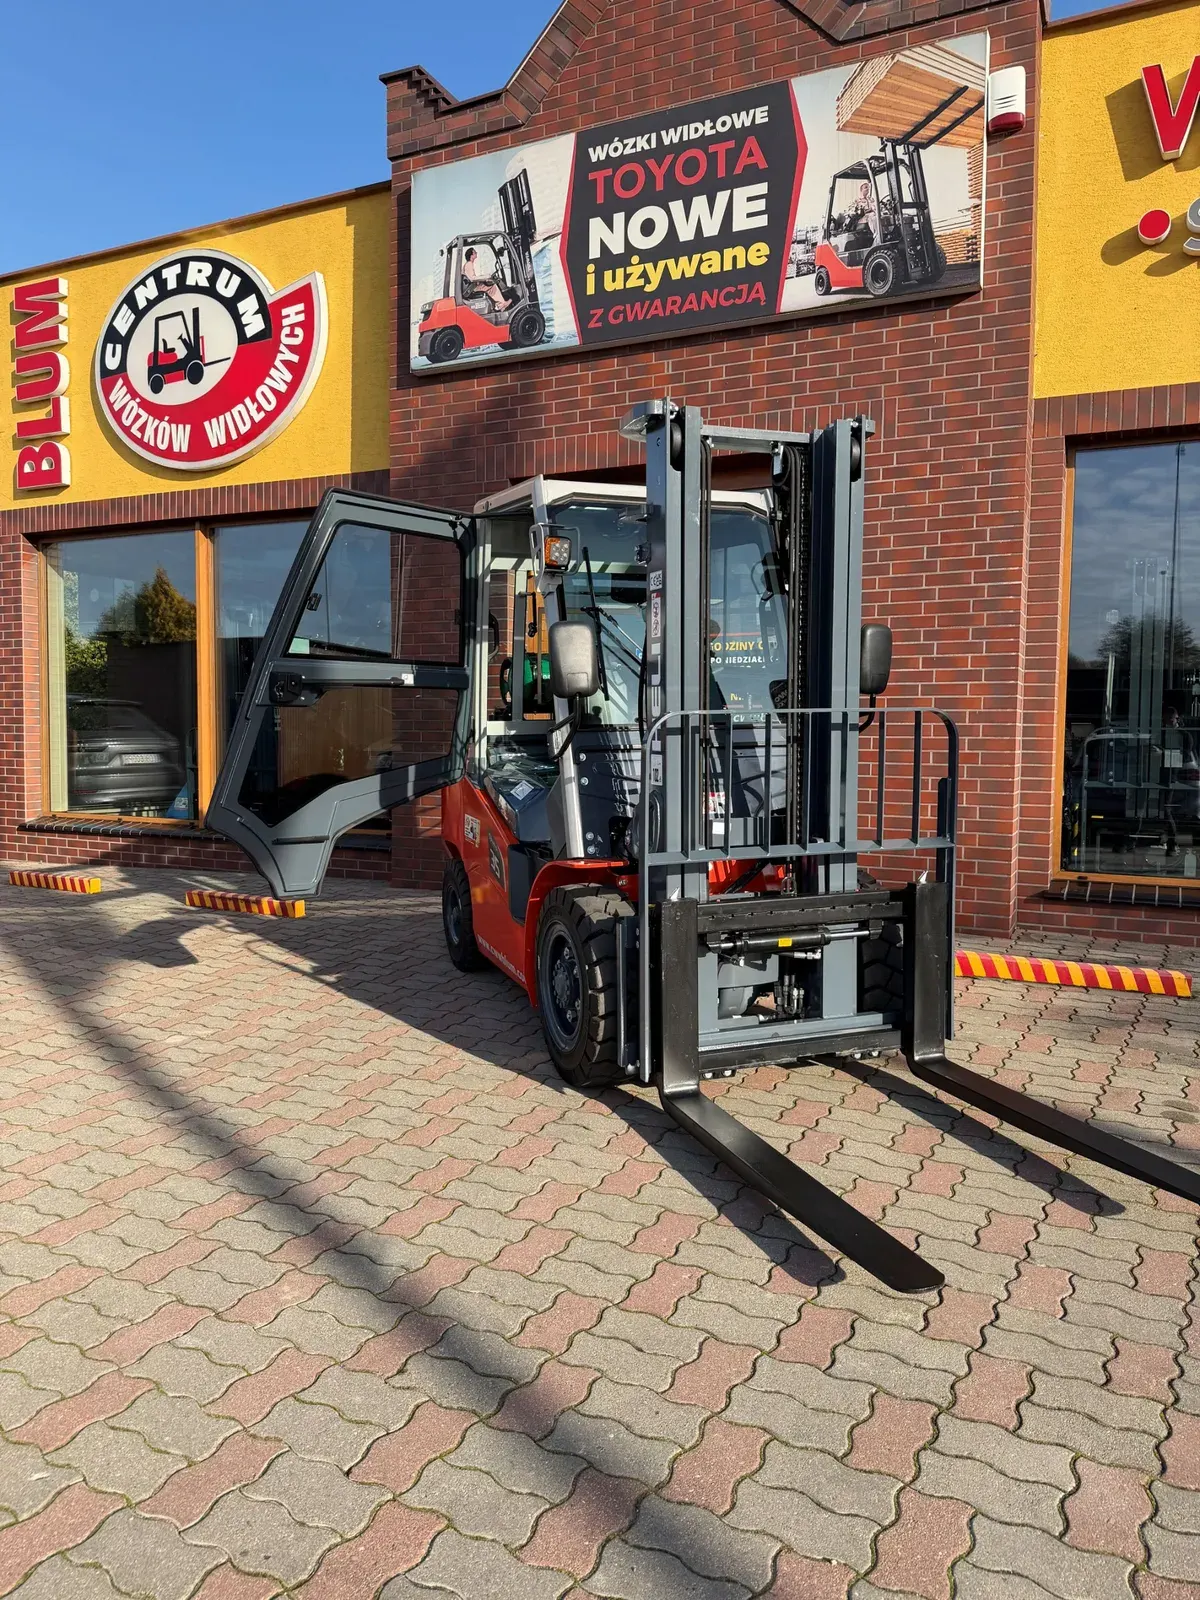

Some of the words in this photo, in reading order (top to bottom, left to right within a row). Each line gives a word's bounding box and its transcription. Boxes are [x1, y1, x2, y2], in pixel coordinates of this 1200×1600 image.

[588, 132, 657, 163] WÓZKI
[660, 105, 769, 146] WIDŁOWE
[588, 136, 769, 204] TOYOTA
[588, 181, 769, 260] NOWE
[586, 263, 596, 296] i
[603, 241, 770, 293] używane
[588, 308, 604, 329] Z
[607, 281, 767, 325] GWARANCJĄ
[105, 260, 266, 371] CENTRUM
[14, 277, 69, 489] BLUM
[107, 377, 191, 453] WÓZKÓW
[203, 302, 306, 448] WIDŁOWYCH
